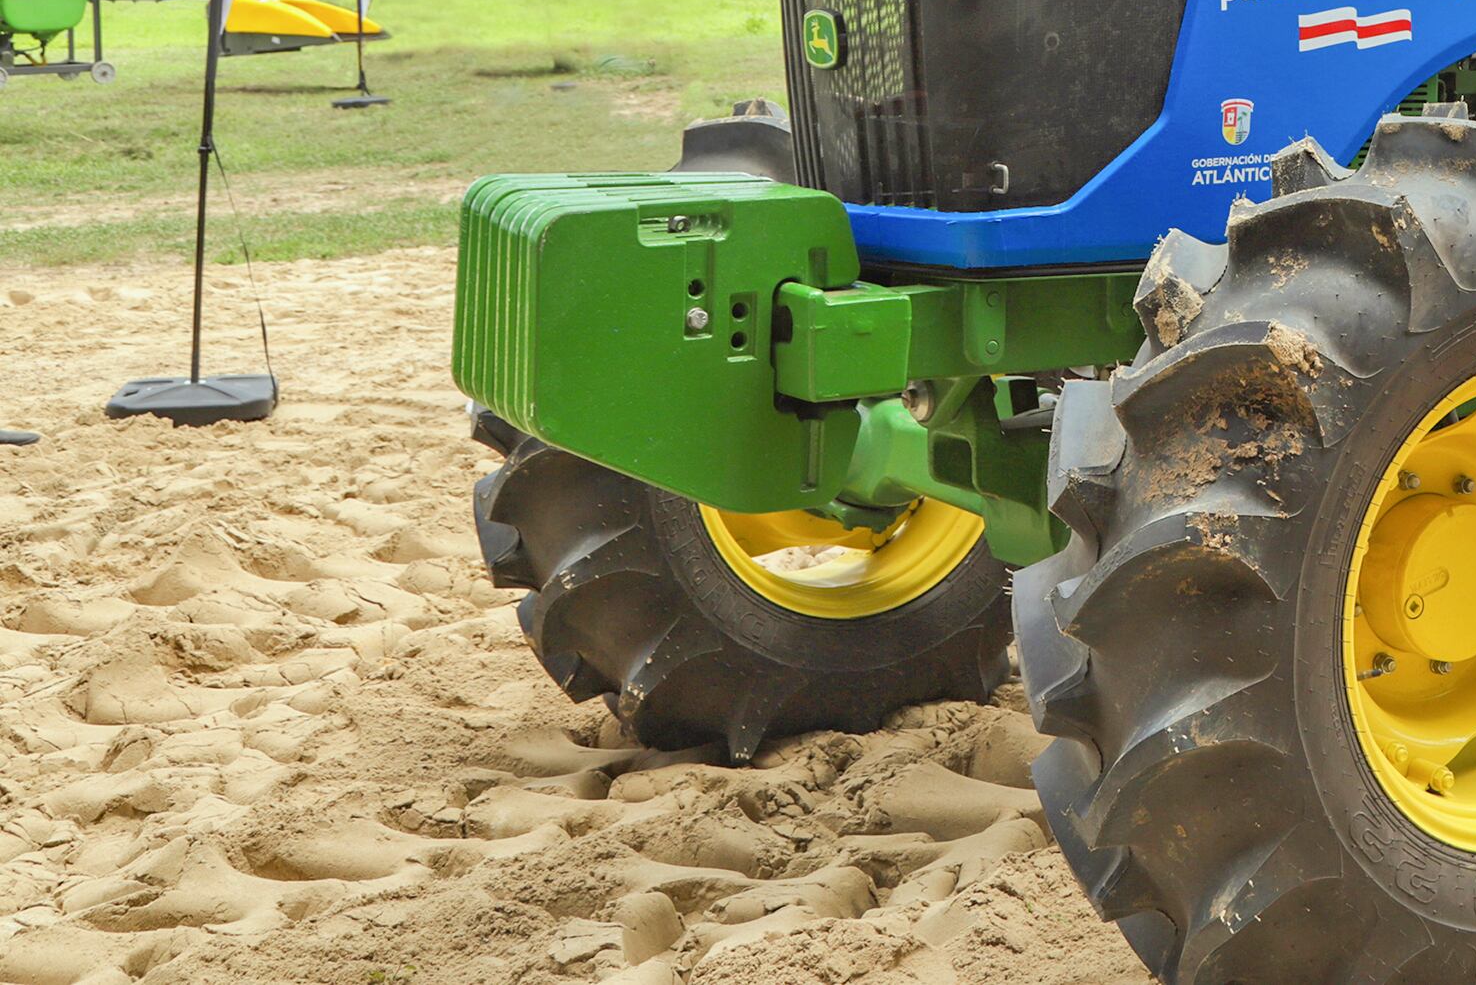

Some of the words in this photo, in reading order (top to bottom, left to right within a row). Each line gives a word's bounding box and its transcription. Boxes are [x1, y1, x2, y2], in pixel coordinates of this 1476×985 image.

[1191, 153, 1261, 168] GOBERNACIÓN
[1191, 166, 1272, 185] ATLÁNTIC
[1350, 794, 1442, 903] 22
